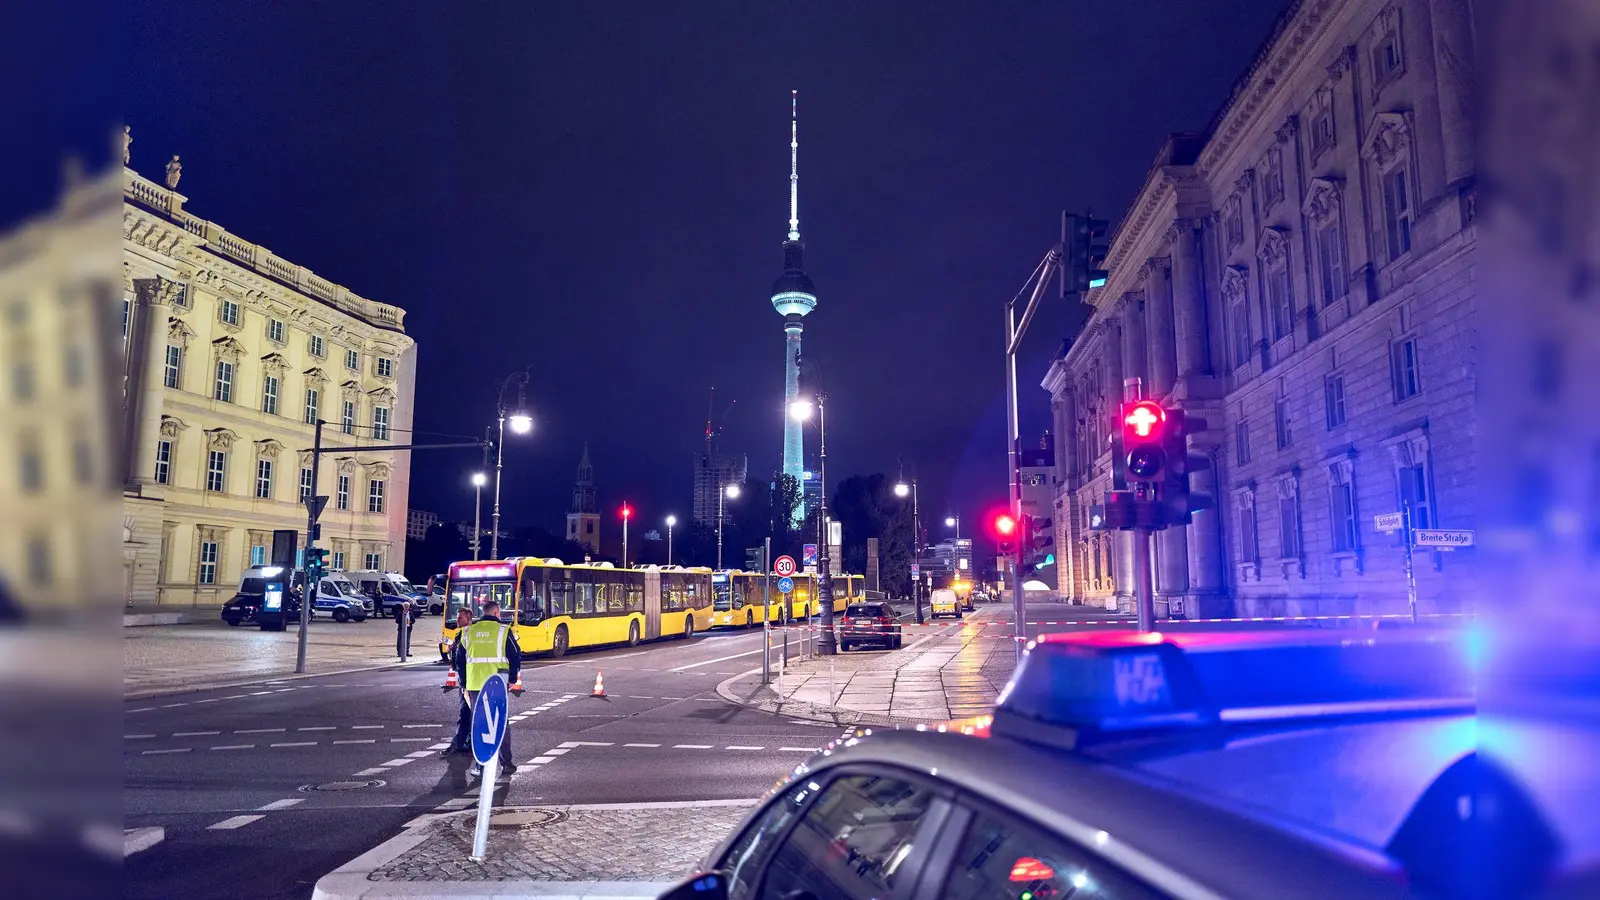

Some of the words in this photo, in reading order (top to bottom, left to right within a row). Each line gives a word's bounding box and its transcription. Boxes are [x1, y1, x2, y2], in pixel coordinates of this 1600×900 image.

[1420, 533, 1443, 542] Breite
[1444, 533, 1469, 544] Straße
[778, 561, 791, 572] 30
